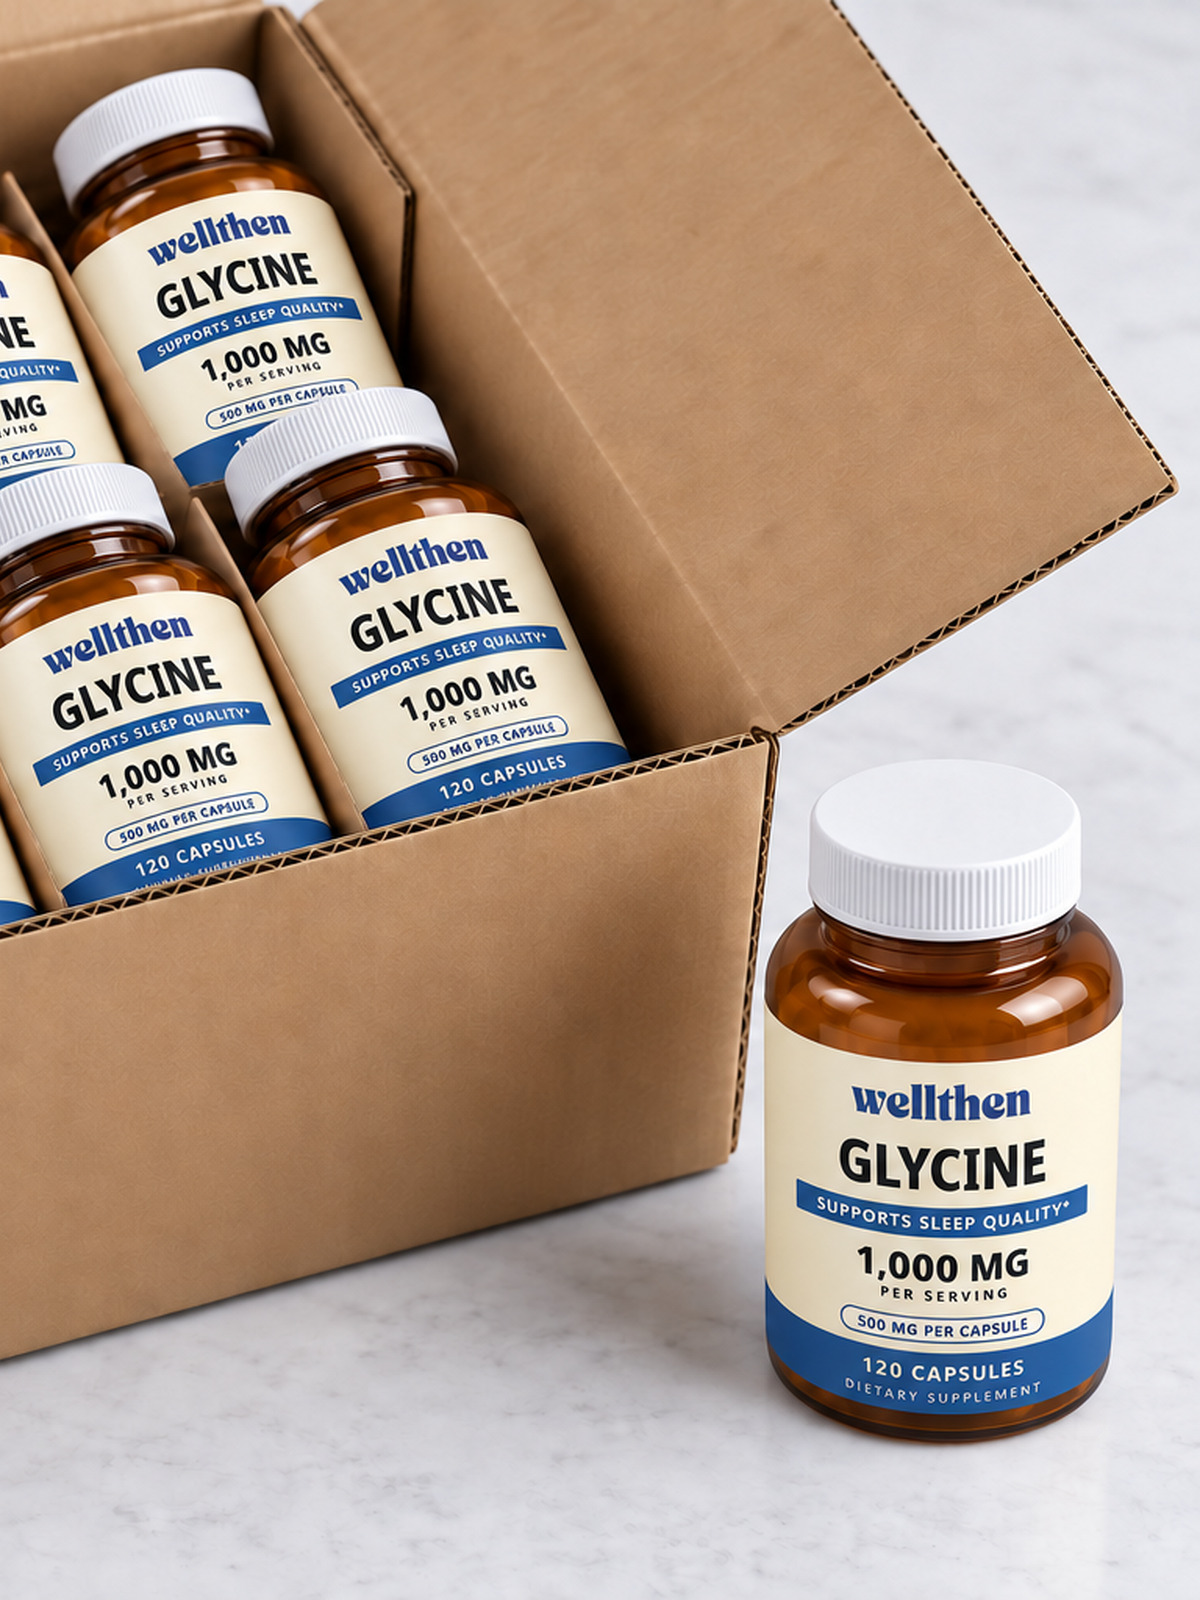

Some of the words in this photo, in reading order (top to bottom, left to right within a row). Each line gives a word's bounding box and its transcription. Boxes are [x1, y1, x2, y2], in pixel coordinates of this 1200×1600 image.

[148, 212, 291, 266] wellthen
[157, 253, 318, 319] GLYCINE
[157, 320, 229, 357] SUPPORTS
[234, 308, 275, 327] SLEEP
[201, 341, 277, 381] 1,000
[283, 332, 331, 359] MG
[227, 377, 253, 391] PER
[259, 362, 321, 381] SERVING
[0, 395, 47, 421] MG
[245, 400, 266, 413] MG
[269, 394, 293, 407] PER
[339, 538, 488, 596] wellthen
[351, 579, 519, 652] GLYCINE
[42, 616, 193, 674] wellthen
[352, 654, 430, 693] SUPPORTS
[434, 640, 477, 661] SLEEP
[53, 655, 222, 730] GLYCINE
[400, 677, 482, 721] 1,000
[487, 666, 537, 696] MG
[429, 716, 457, 731] PER
[464, 697, 528, 721] SERVING
[53, 732, 129, 771] SUPPORTS
[133, 718, 177, 739] SLEEP
[449, 741, 472, 757] MG
[99, 754, 180, 798] 1,000
[186, 742, 237, 773] MG
[127, 793, 155, 809] PER
[162, 774, 227, 798] SERVING
[440, 778, 474, 799] 120
[481, 755, 566, 786] CAPSULES
[120, 826, 143, 843] 500
[147, 818, 169, 833] MG
[136, 855, 169, 876] 120
[176, 831, 265, 863] CAPSULES
[852, 1084, 1030, 1121] wellthen
[839, 1138, 1046, 1192] GLYCINE
[817, 1196, 911, 1228] SUPPORTS
[920, 1216, 975, 1230] SLEEP
[857, 1246, 958, 1283] 1,000
[971, 1248, 1028, 1282] MG
[881, 1286, 913, 1300] PER
[924, 1287, 1007, 1302] SERVING
[858, 1314, 886, 1331] 500
[892, 1321, 917, 1335] MG
[925, 1325, 953, 1337] PER
[960, 1318, 1027, 1337] CAPSULE
[846, 1378, 917, 1401] DIETARY
[928, 1381, 1040, 1403] SUPPLEMENT
[863, 1357, 902, 1378] 120
[912, 1359, 1024, 1382] CAPSULES
